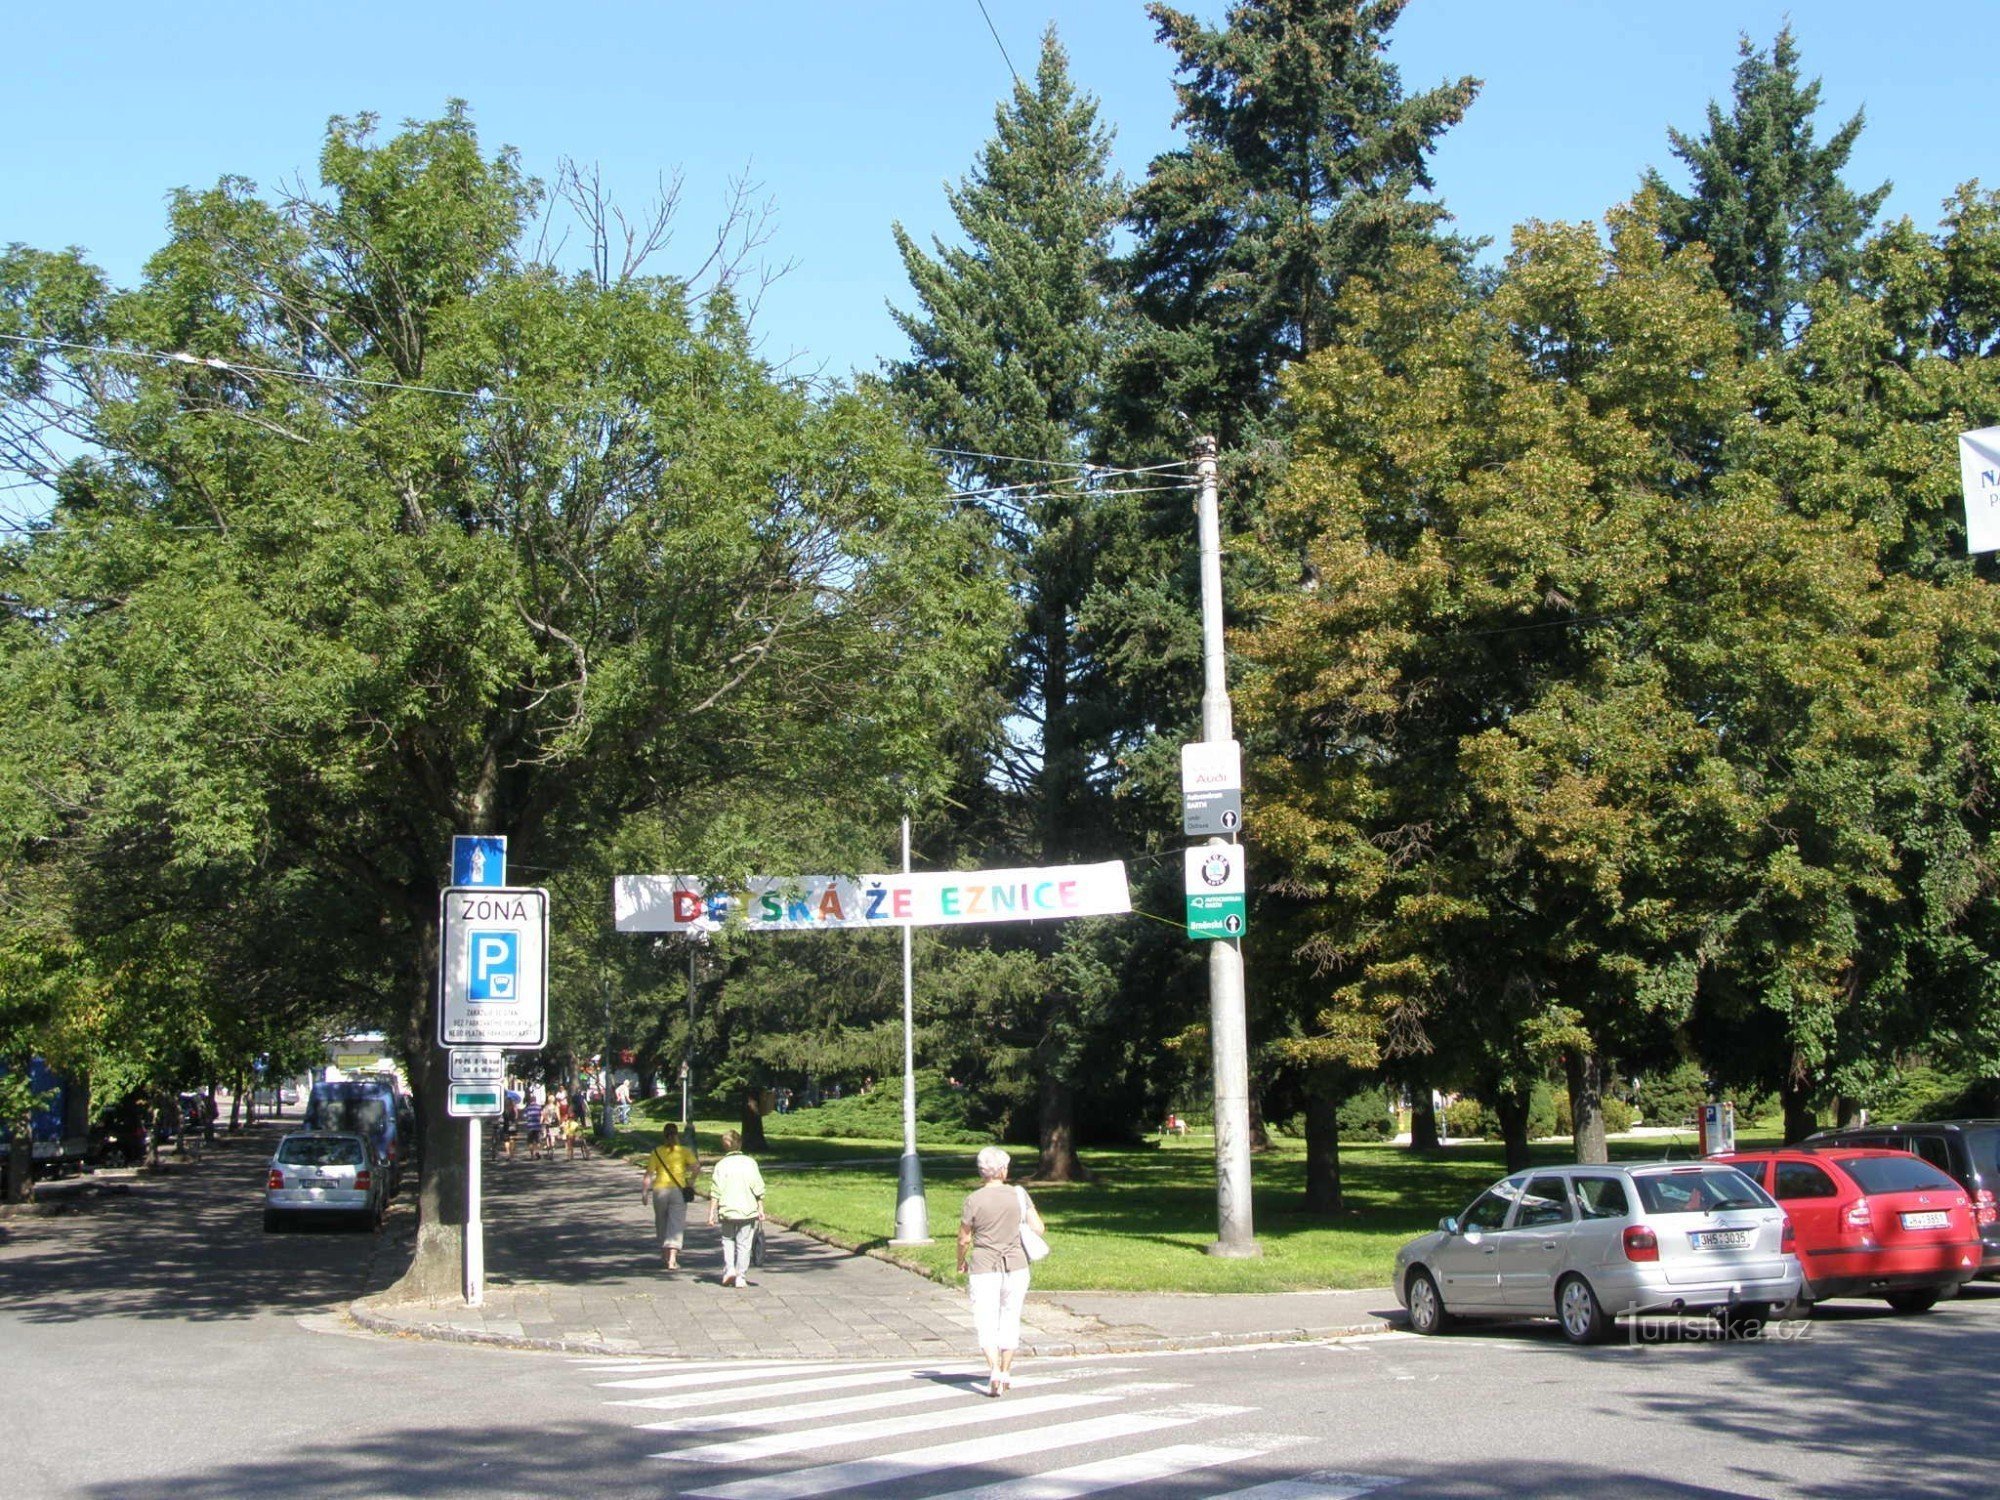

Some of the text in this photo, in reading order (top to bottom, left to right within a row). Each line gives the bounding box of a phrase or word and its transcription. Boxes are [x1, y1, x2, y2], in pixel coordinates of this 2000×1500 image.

[1981, 469, 2000, 488] N
[1196, 772, 1227, 784] Audi
[462, 895, 527, 921] ZÓNA
[478, 938, 509, 980] P
[1724, 1231, 1746, 1244] 3035
